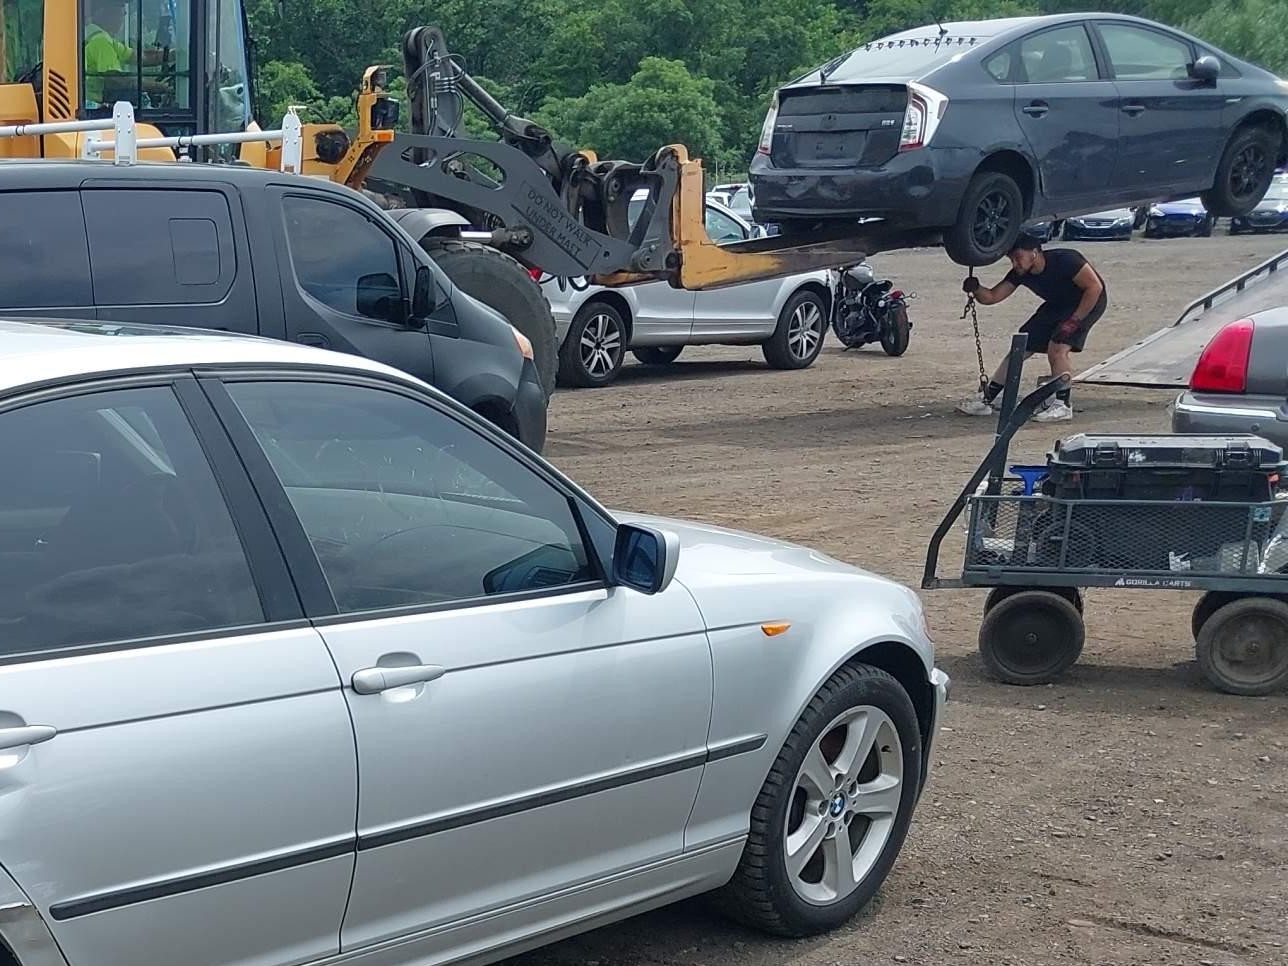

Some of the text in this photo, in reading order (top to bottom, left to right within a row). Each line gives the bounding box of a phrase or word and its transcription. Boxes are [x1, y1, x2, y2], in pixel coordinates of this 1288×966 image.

[526, 206, 557, 236] UNDER
[527, 190, 591, 247] DO NOT WALK
[1125, 578, 1160, 586] GORILLA
